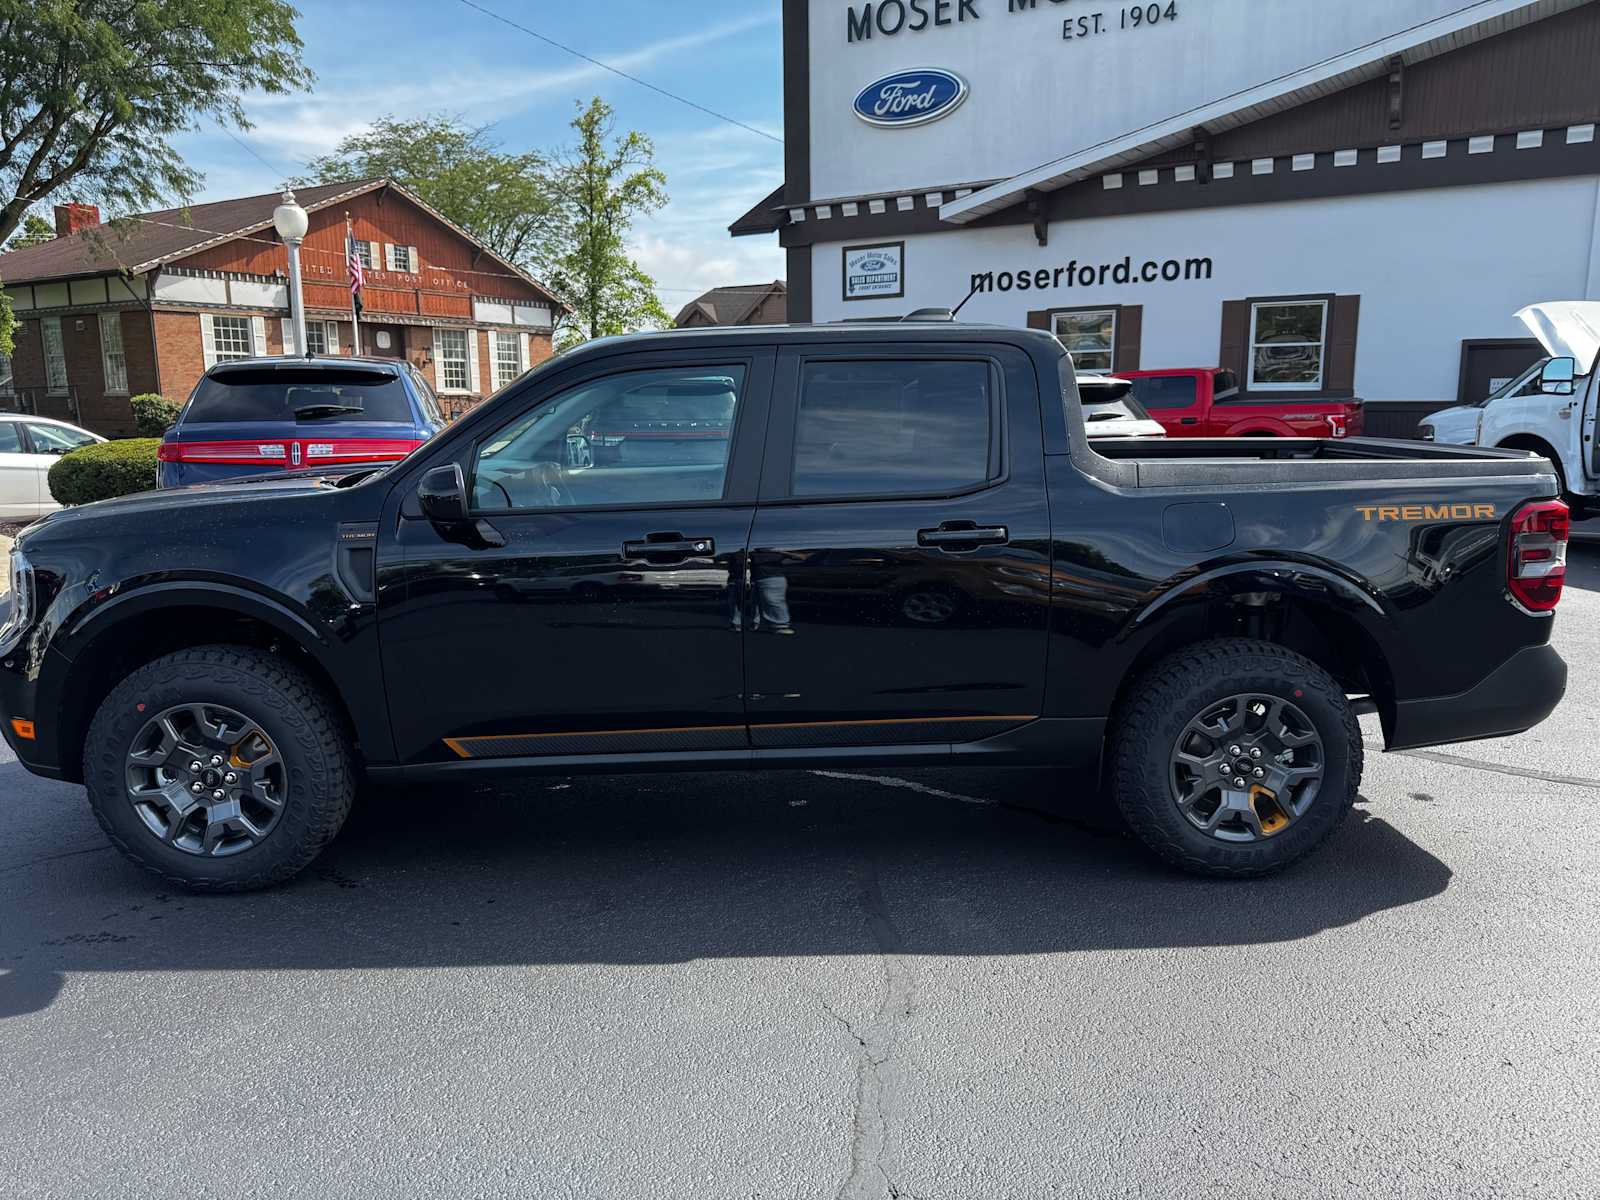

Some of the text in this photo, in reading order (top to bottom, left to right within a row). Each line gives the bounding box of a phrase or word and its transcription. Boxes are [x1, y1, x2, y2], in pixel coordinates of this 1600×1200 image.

[847, 0, 981, 43] MOSER
[1061, 0, 1178, 41] EST. 1904
[873, 80, 937, 116] Ford
[970, 256, 1213, 293] moserford.com
[1355, 503, 1496, 521] TREMOR
